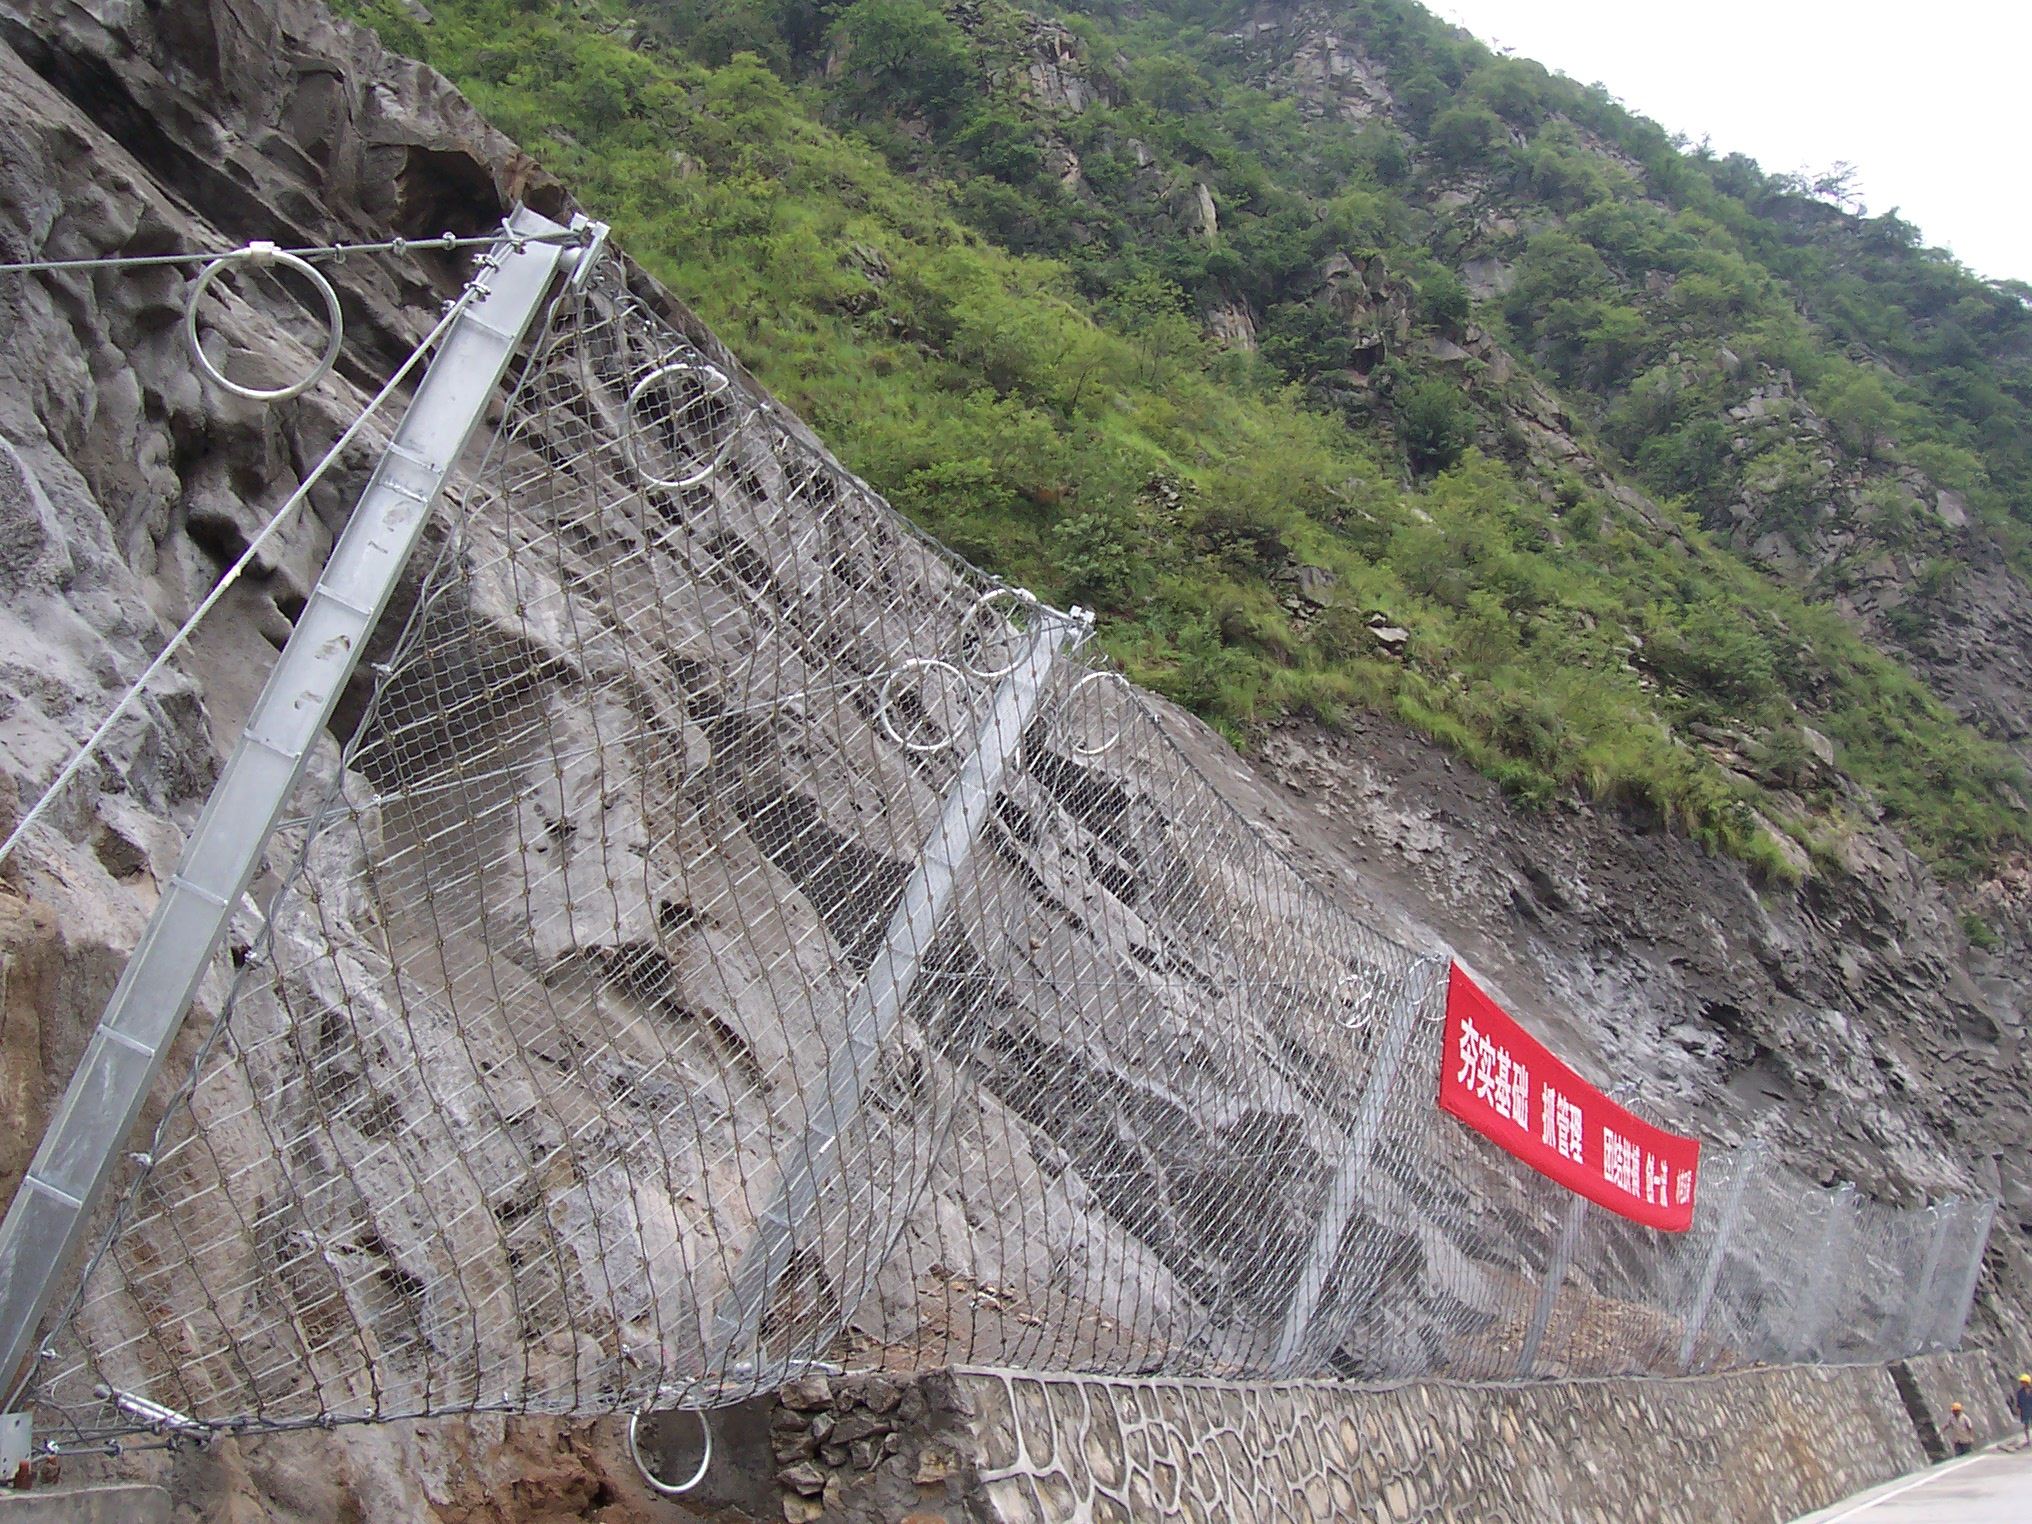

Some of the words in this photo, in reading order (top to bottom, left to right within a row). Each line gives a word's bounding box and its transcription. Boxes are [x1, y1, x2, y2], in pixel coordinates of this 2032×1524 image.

[1458, 1017, 1529, 1132] 夯实基础
[1541, 1082, 1584, 1164] 抓管理
